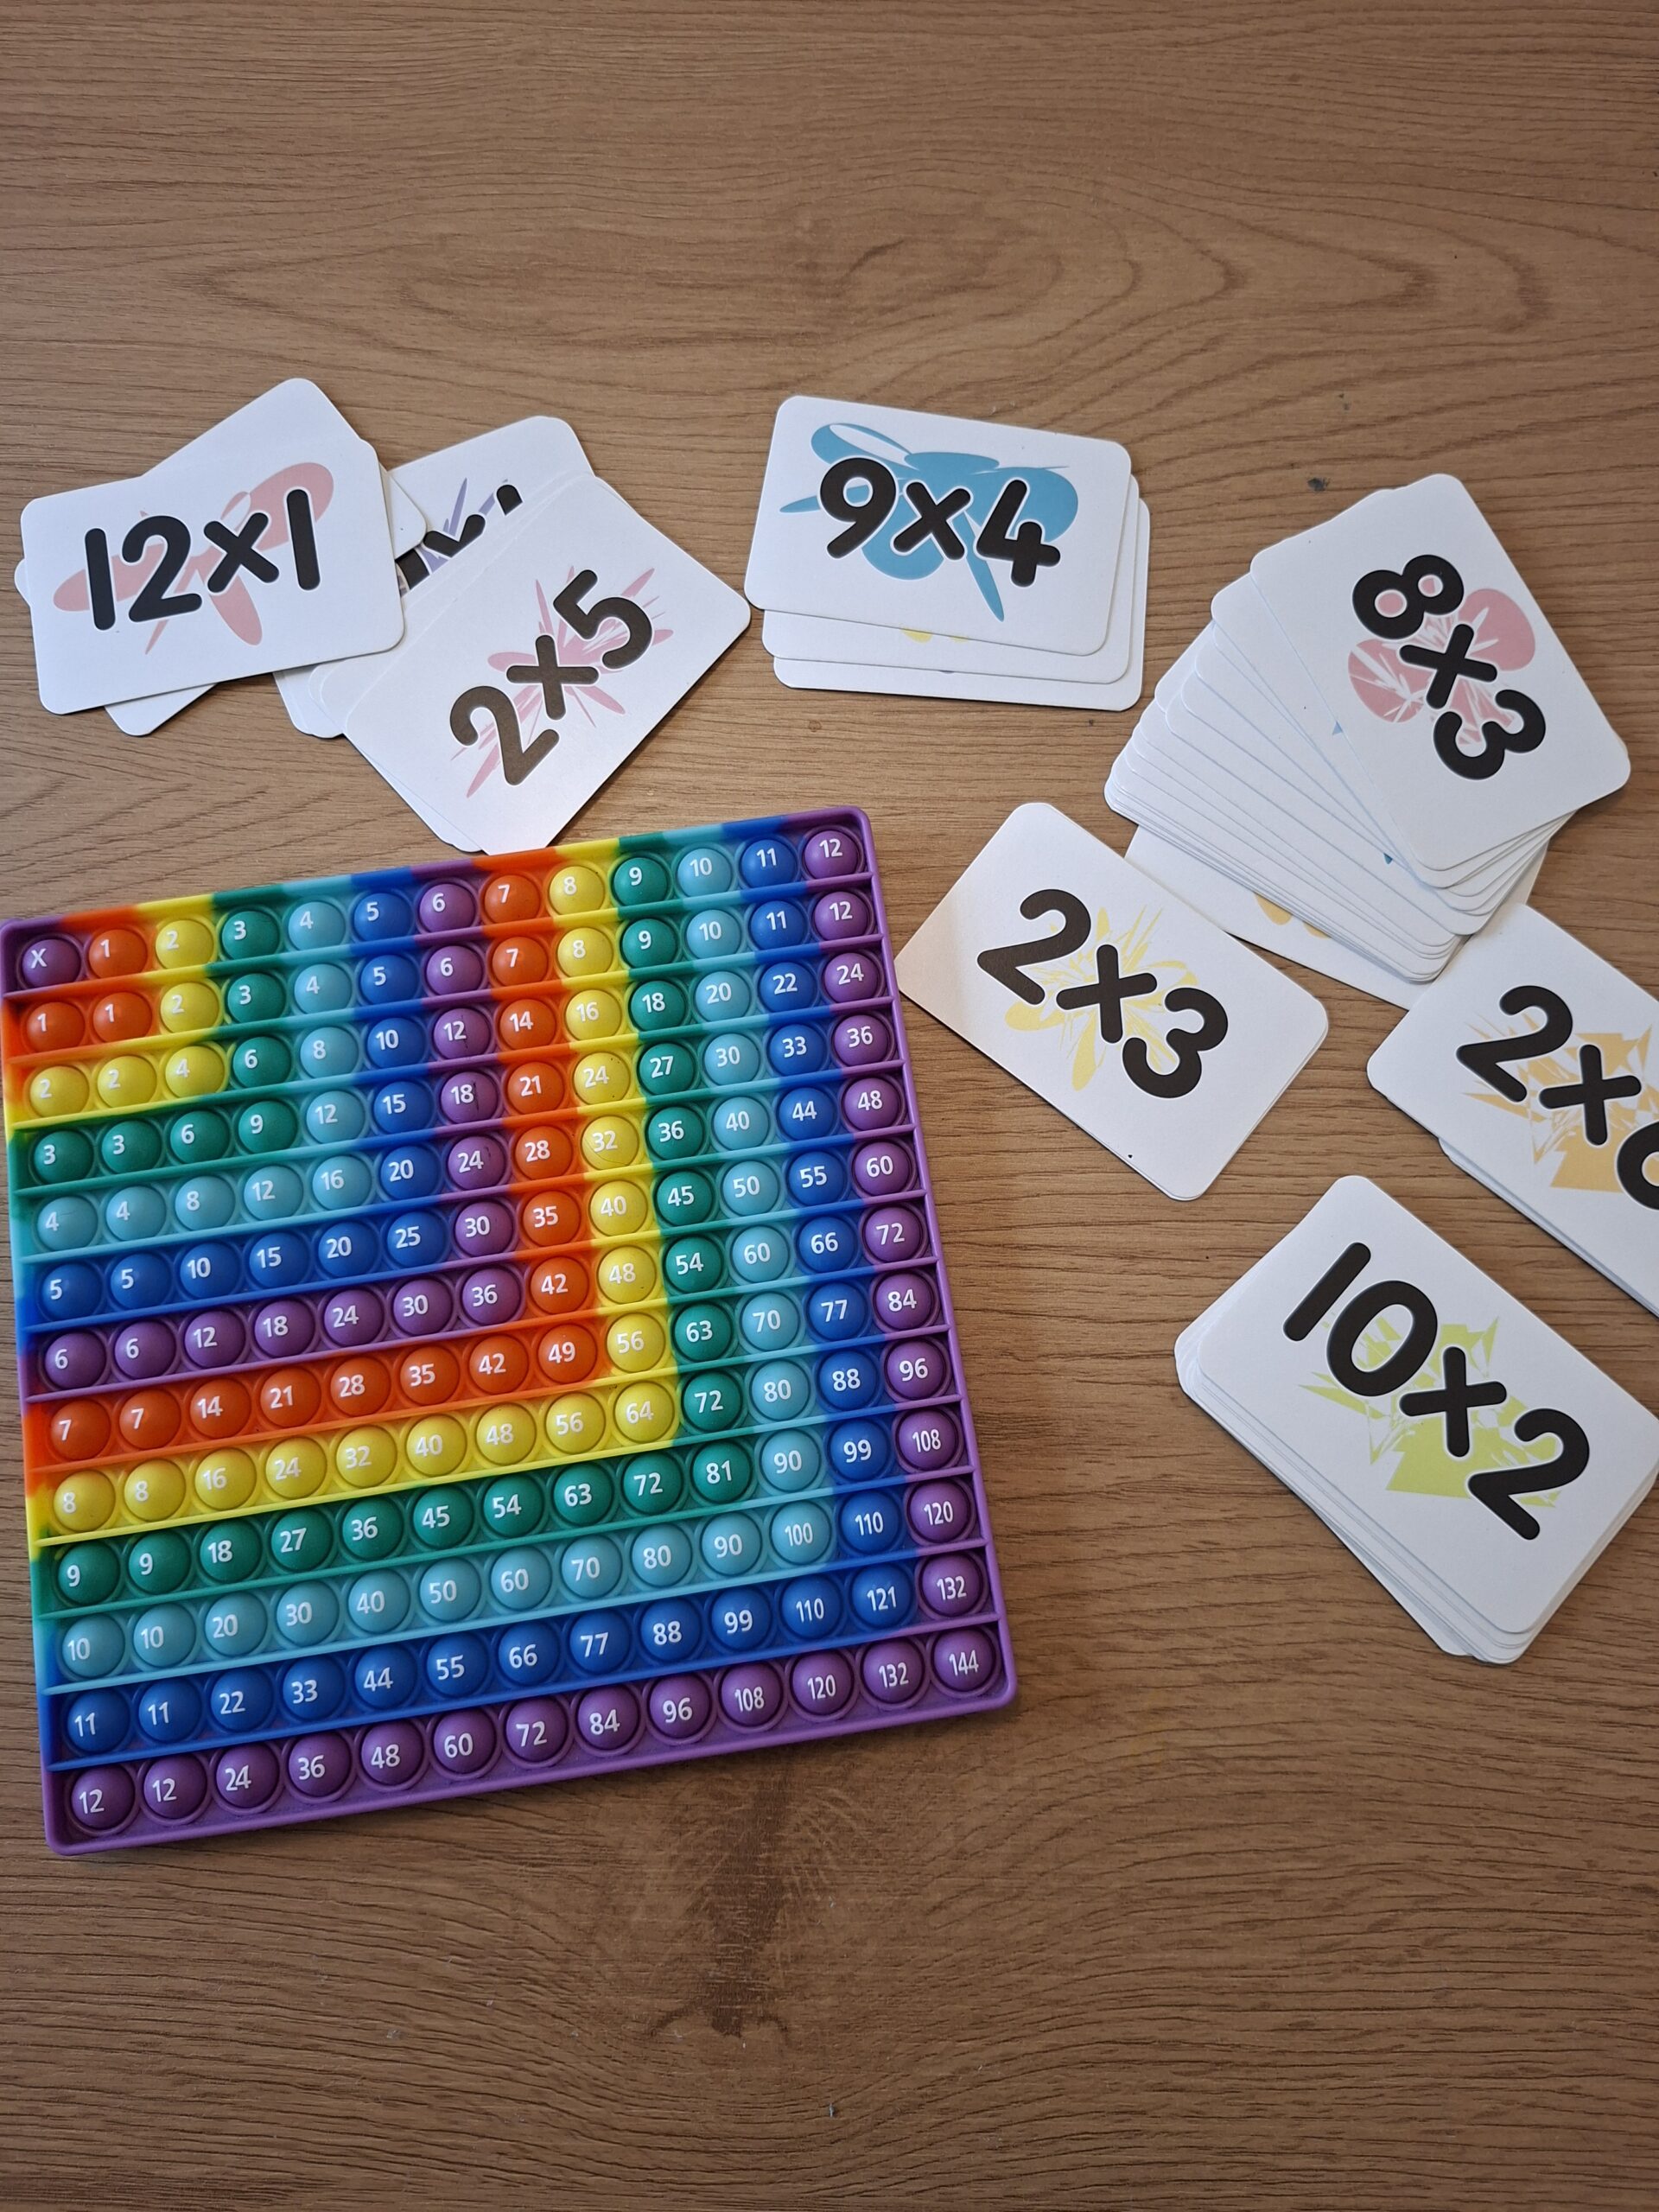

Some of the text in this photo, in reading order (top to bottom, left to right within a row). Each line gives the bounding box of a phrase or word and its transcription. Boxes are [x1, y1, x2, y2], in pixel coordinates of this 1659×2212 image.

[86, 489, 320, 630] 12x1
[820, 458, 1060, 586] 9x4
[450, 569, 654, 785] 2x5
[1352, 554, 1546, 780] 8x3
[233, 920, 246, 940] 3
[299, 910, 314, 930] 4
[365, 901, 379, 921] 5
[432, 893, 446, 912] 6
[498, 883, 511, 904] 7
[628, 866, 643, 886] 9
[690, 857, 713, 877] 10
[756, 848, 777, 868] 11
[819, 838, 843, 858] 12
[238, 900, 853, 1005] 3 4 5 6 7 9 10 11 12
[244, 963, 864, 1069] 6 8 10 12 14 18 20 22 24
[977, 889, 1228, 1098] 2x3
[43, 1026, 874, 1165] 3 3 6 9 12 15 18 21 27 30 33 36
[45, 1090, 883, 1232] 4 4 8 12 16 20 24 28 36 40 44 48
[49, 1155, 893, 1300] 5 5 10 15 20 25 30 35 45 50 55 60
[54, 1222, 906, 1370] 6 6 12 18 24 30 36 42 54 60 66 72
[130, 1288, 918, 1430] 7 14 21 28 35 42 49 63 70 77 84
[694, 1357, 929, 1414] 72 80 88 96
[1283, 1242, 1590, 1541] 10x2
[67, 1428, 942, 1587] 9 9 18 27 36 45 54 63 72 81 90 99 108
[67, 1501, 954, 1662] 10 10 20 30 40 50 60 70 80 90 100 110 120
[74, 1575, 967, 1737] 11 11 22 33 44 55 66 77 88 99 110 121 132
[79, 1649, 979, 1815] 12 12 24 36 48 60 72 84 96 108 120 132 144
